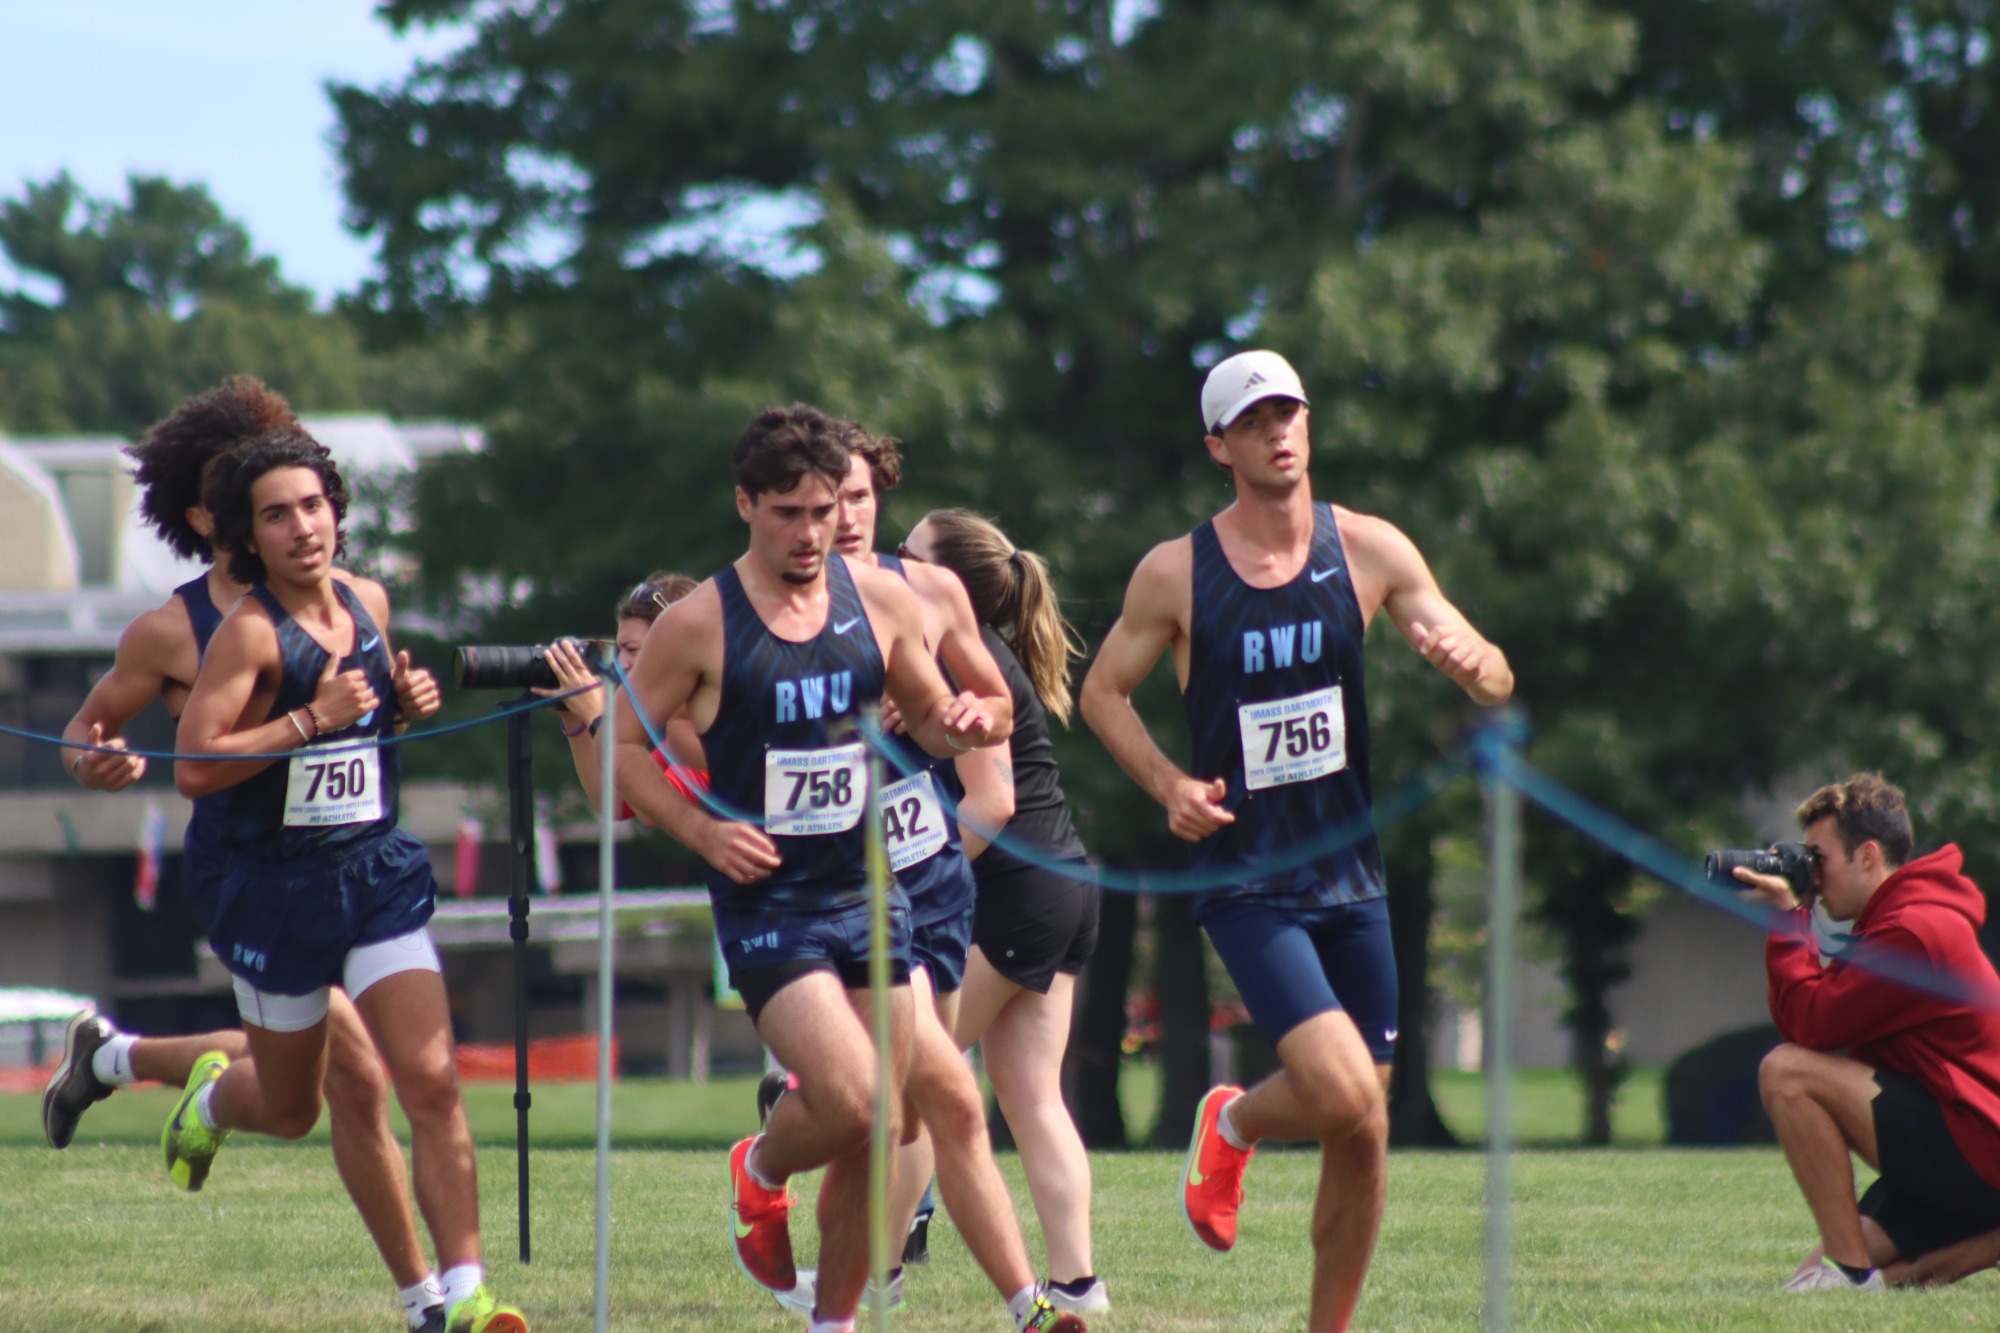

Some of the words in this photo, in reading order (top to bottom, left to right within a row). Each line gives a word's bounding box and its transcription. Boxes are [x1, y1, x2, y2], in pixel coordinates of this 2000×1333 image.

[1243, 620, 1323, 674] RWU
[775, 671, 853, 724] RWU
[1250, 706, 1282, 720] UMASS
[1284, 694, 1333, 714] DARTMOUTH
[1258, 711, 1331, 763] 756
[777, 757, 809, 767] UMASS
[811, 751, 857, 765] DARTMOUTH
[1286, 765, 1324, 780] ATHLETIC
[304, 758, 365, 803] 750
[783, 767, 852, 811] 758
[880, 778, 921, 803] ARTMOUTH
[322, 812, 357, 823] ATHLETIC
[807, 822, 843, 832] ATHLETIC
[883, 796, 929, 843] 42
[892, 848, 927, 869] ATHLETIC
[232, 942, 266, 973] RWU
